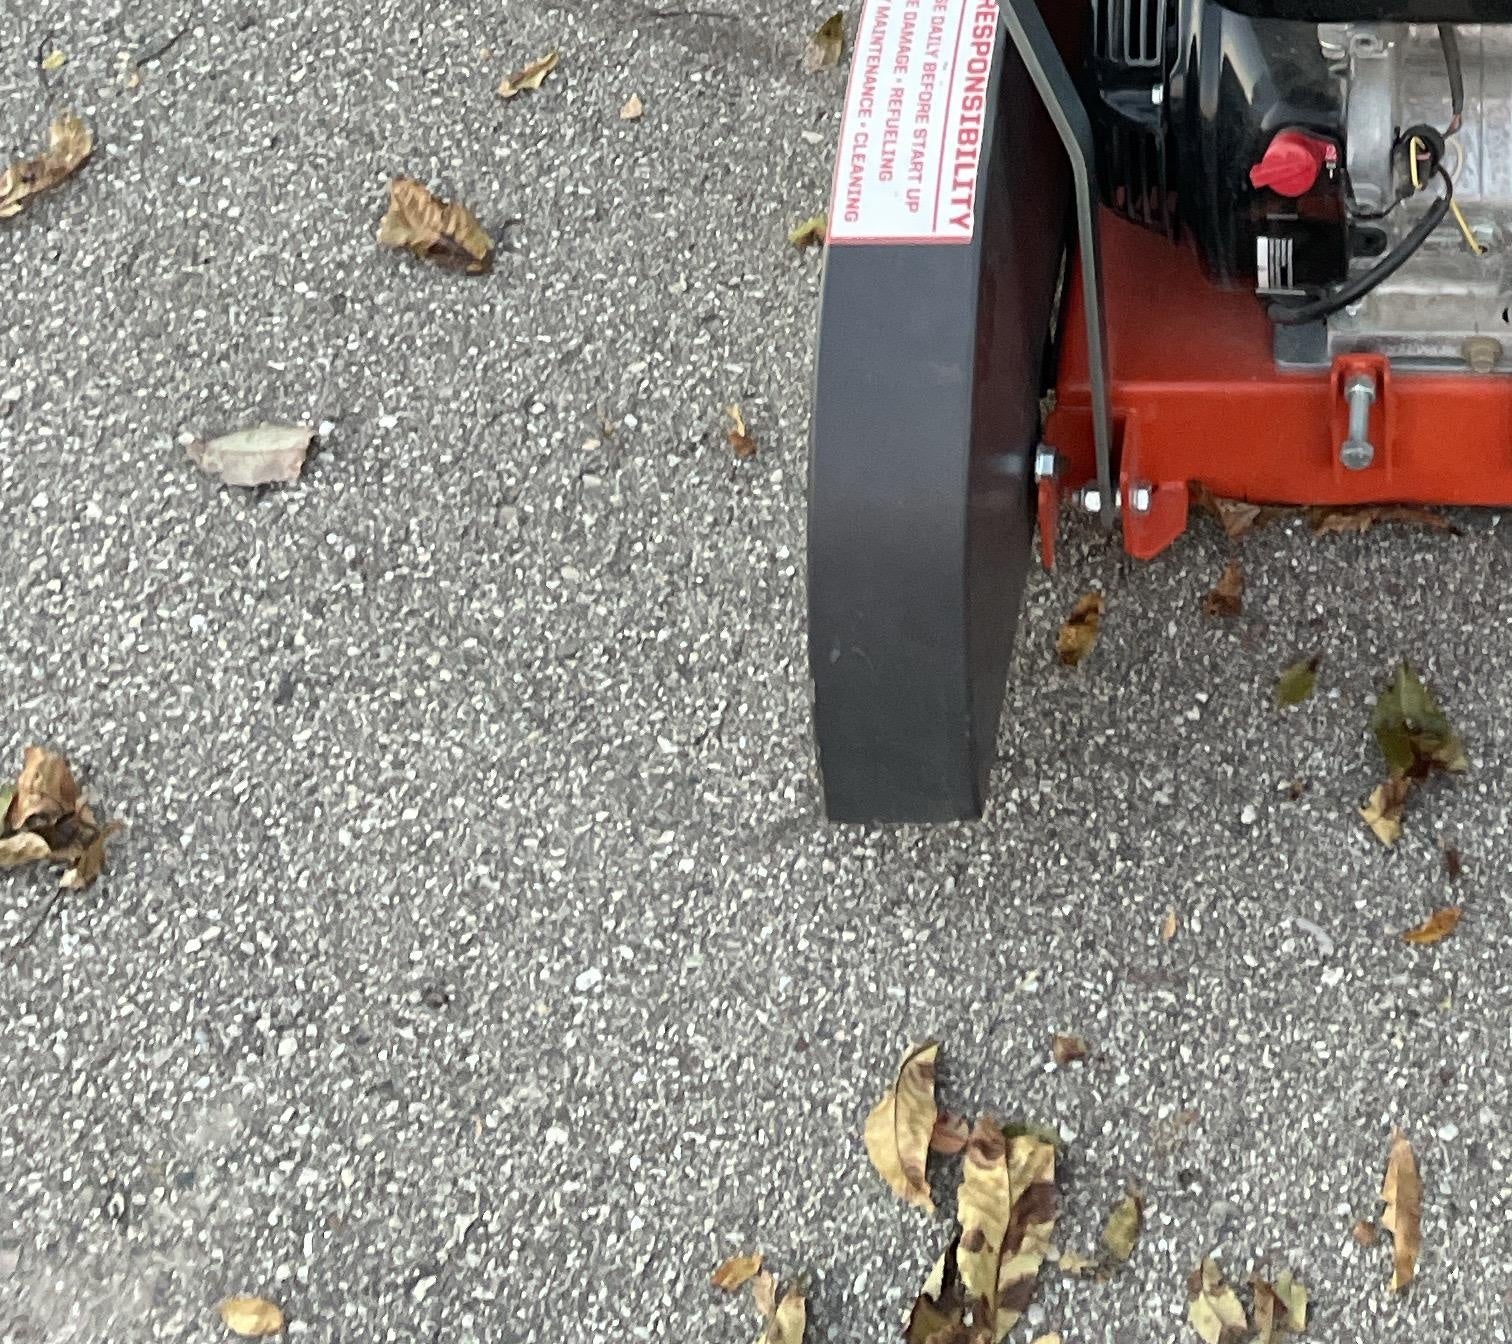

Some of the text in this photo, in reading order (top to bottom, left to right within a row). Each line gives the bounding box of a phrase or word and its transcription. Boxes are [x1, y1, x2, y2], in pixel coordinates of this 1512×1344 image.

[858, 6, 891, 119] MAINTENANCE
[893, 11, 917, 74] DAMAGE
[925, 15, 945, 59] DAILY
[915, 61, 937, 124] BEFORE
[879, 87, 905, 182] REFUELING
[908, 128, 928, 184] START
[844, 131, 869, 223] CLEANING
[905, 188, 921, 213] UP
